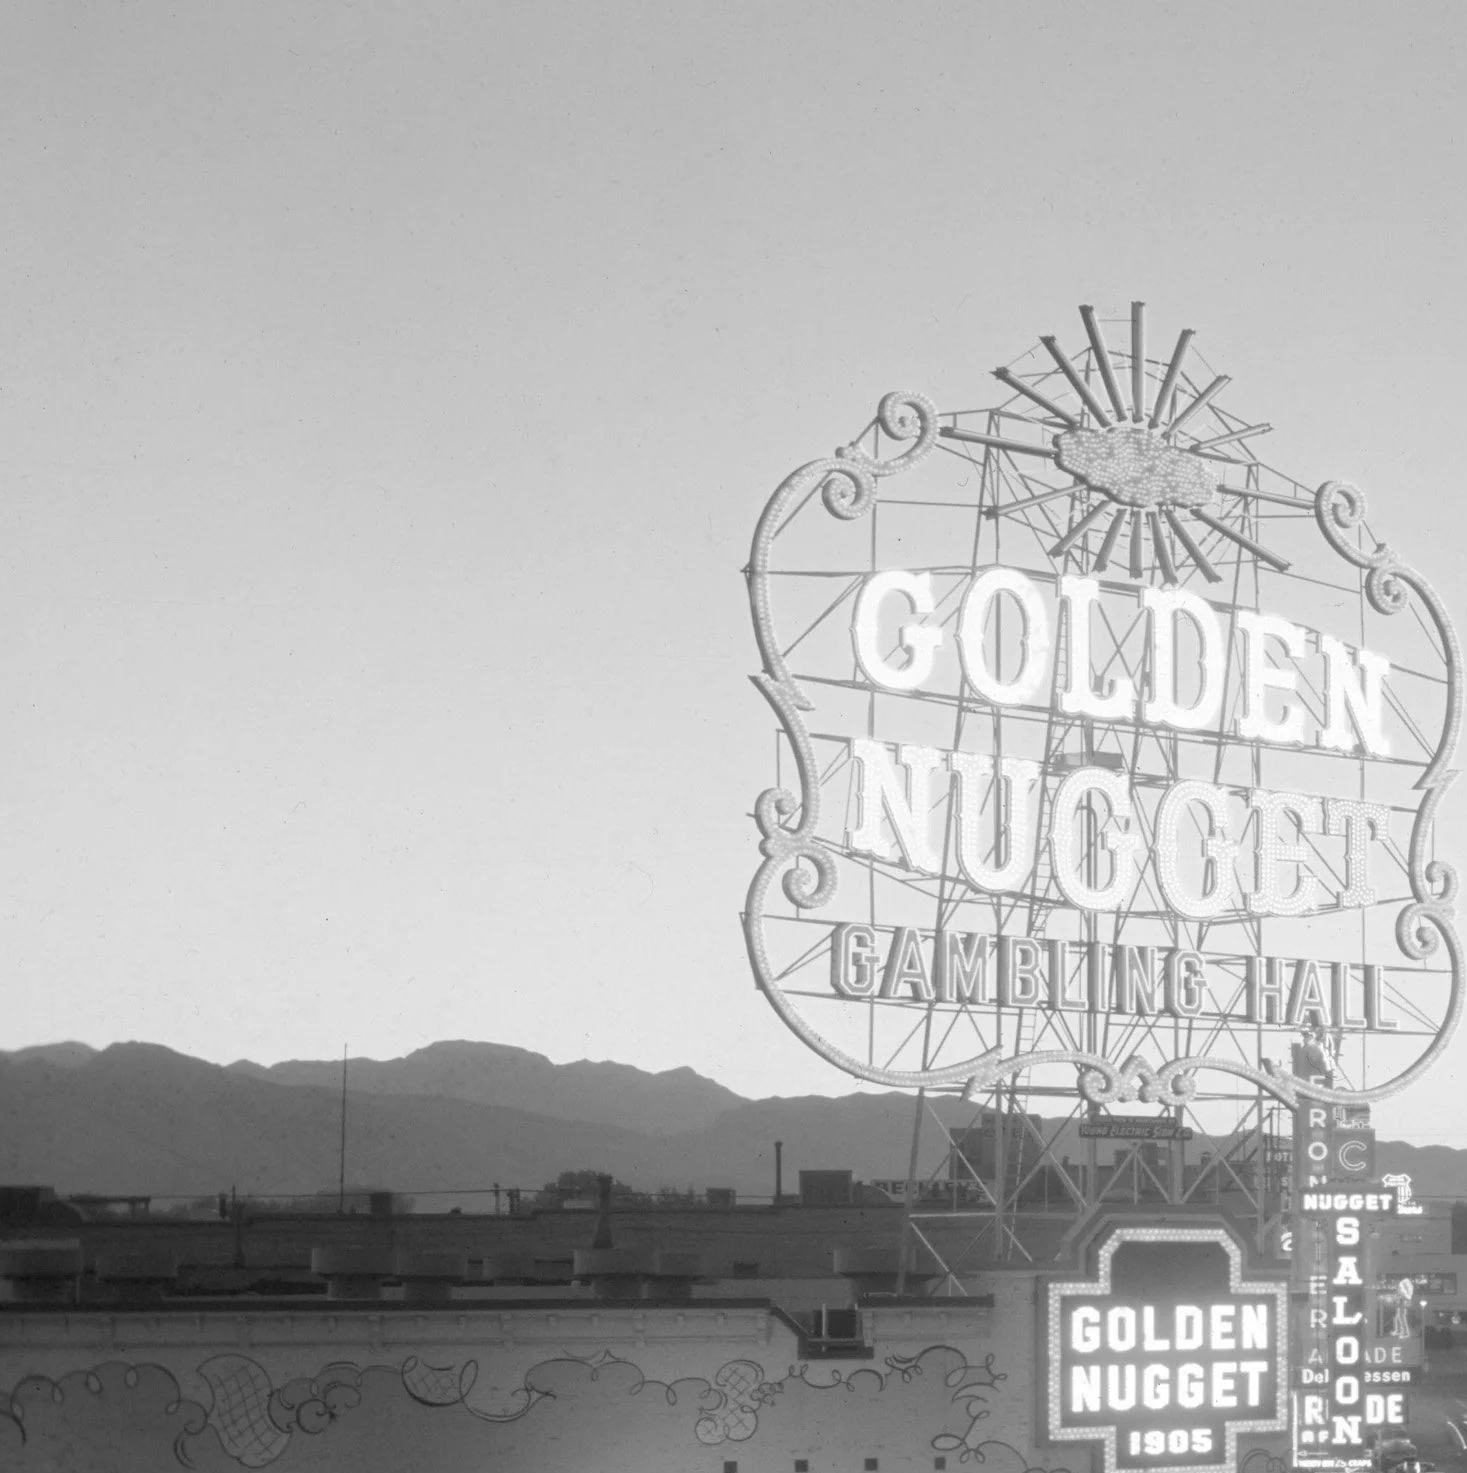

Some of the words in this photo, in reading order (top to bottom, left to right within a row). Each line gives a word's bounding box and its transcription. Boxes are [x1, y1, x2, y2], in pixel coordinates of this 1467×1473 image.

[852, 567, 1396, 756] GOLDEN
[846, 738, 1392, 919] NUGGET
[830, 922, 1208, 1019] GAMBLING
[1246, 953, 1401, 1030] HALL
[1110, 1124, 1151, 1137] ELECTRIC
[1303, 1194, 1392, 1211] NUGGET
[1071, 1304, 1268, 1354] GOLDEN
[1332, 1216, 1363, 1444] SALOON
[1070, 1361, 1268, 1412] NUGGET
[1128, 1429, 1214, 1456] 1905
